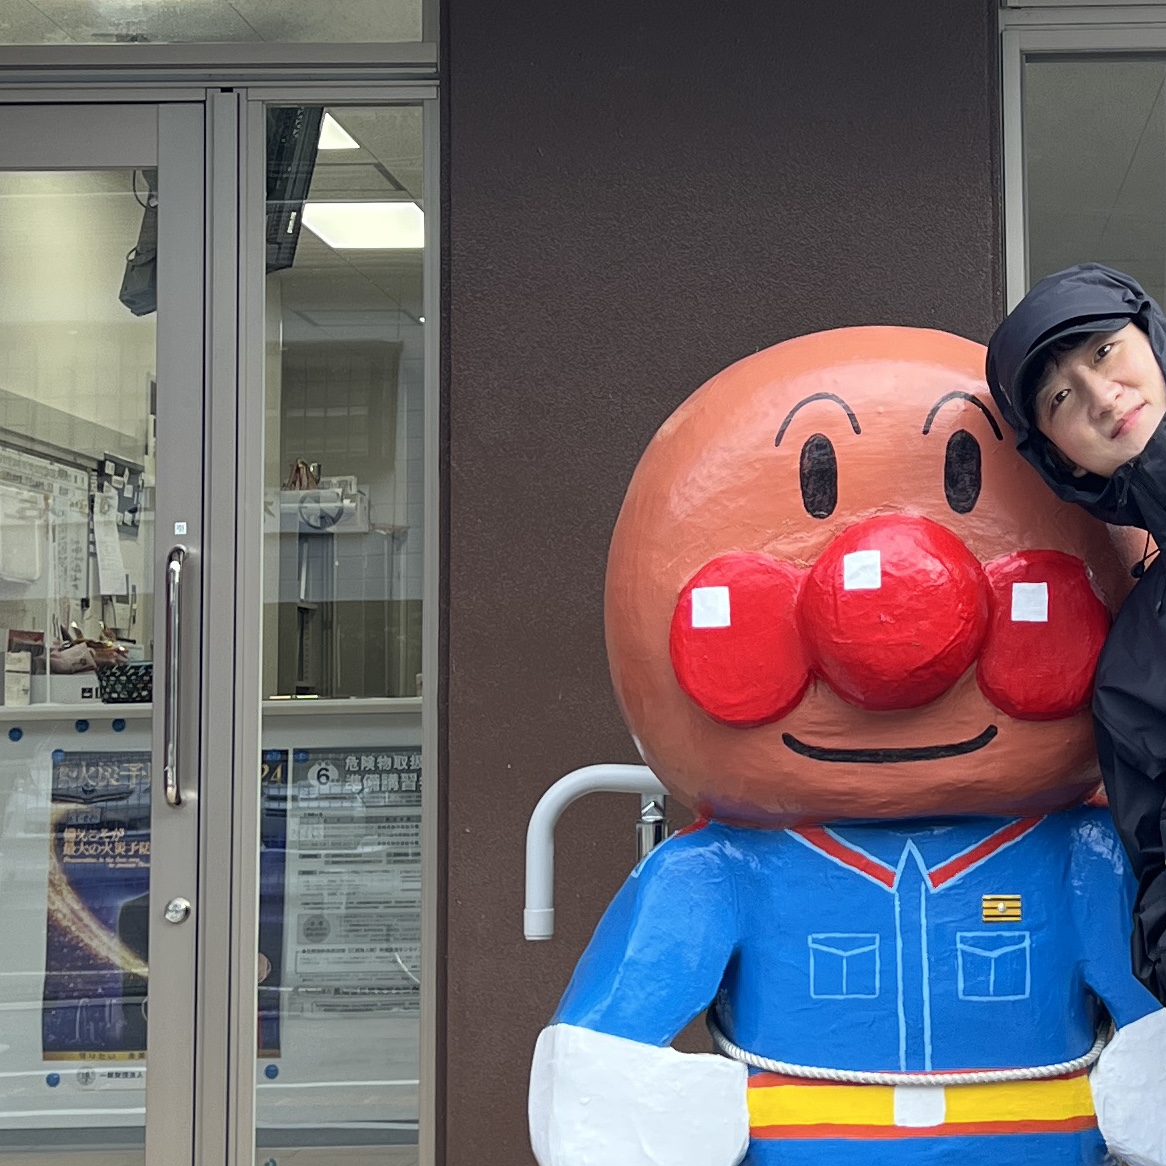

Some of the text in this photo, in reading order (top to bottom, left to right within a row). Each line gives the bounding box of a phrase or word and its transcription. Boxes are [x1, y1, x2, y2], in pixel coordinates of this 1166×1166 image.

[316, 767, 330, 785] 6
[345, 773, 422, 791] 準備講習
